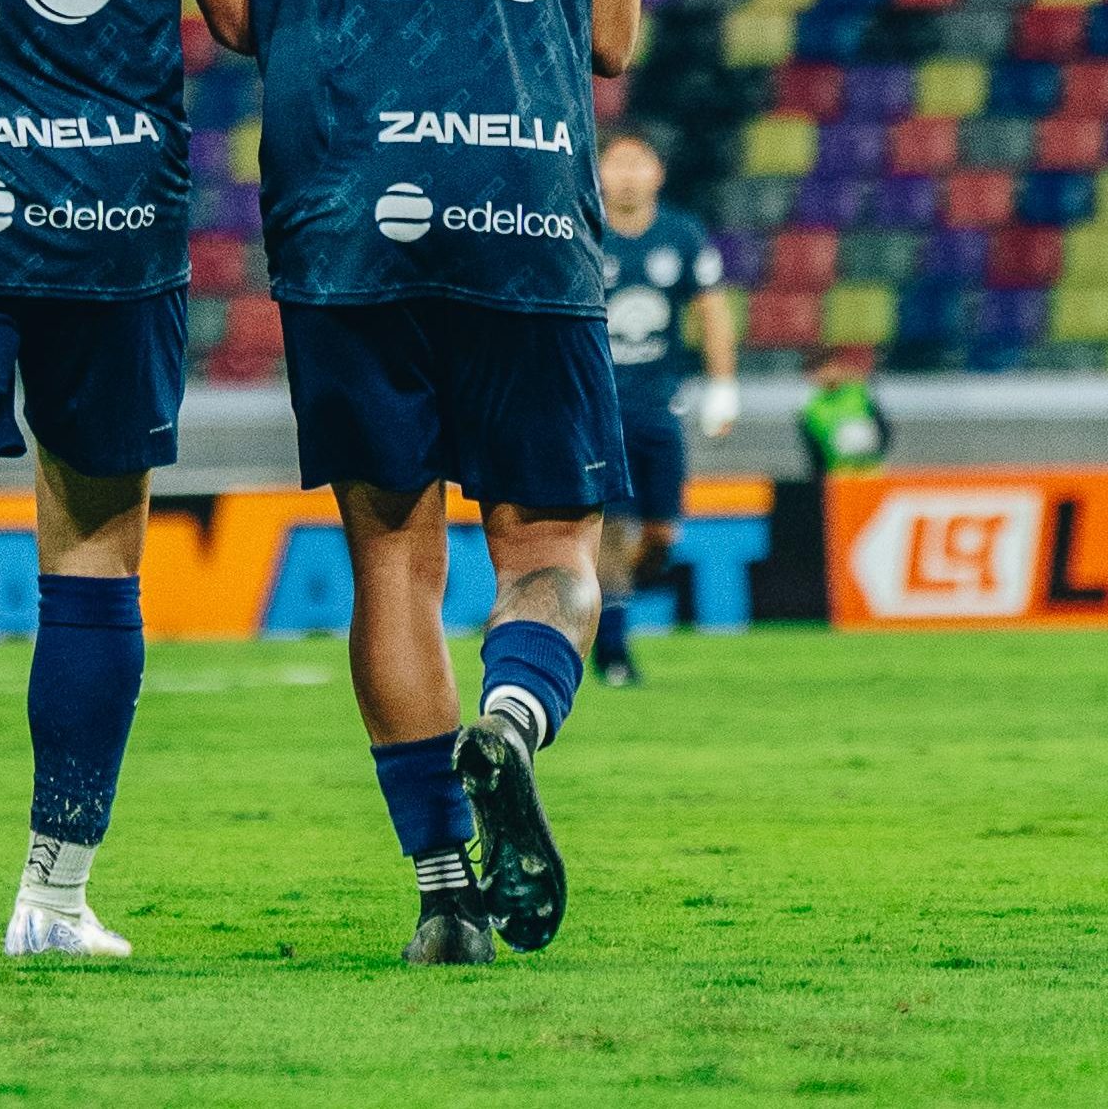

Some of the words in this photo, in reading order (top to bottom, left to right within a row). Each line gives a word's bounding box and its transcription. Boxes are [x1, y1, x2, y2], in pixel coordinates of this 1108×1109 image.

[378, 111, 573, 155] ZANELLA
[24, 199, 157, 231] edelcos
[442, 200, 574, 240] edelcos
